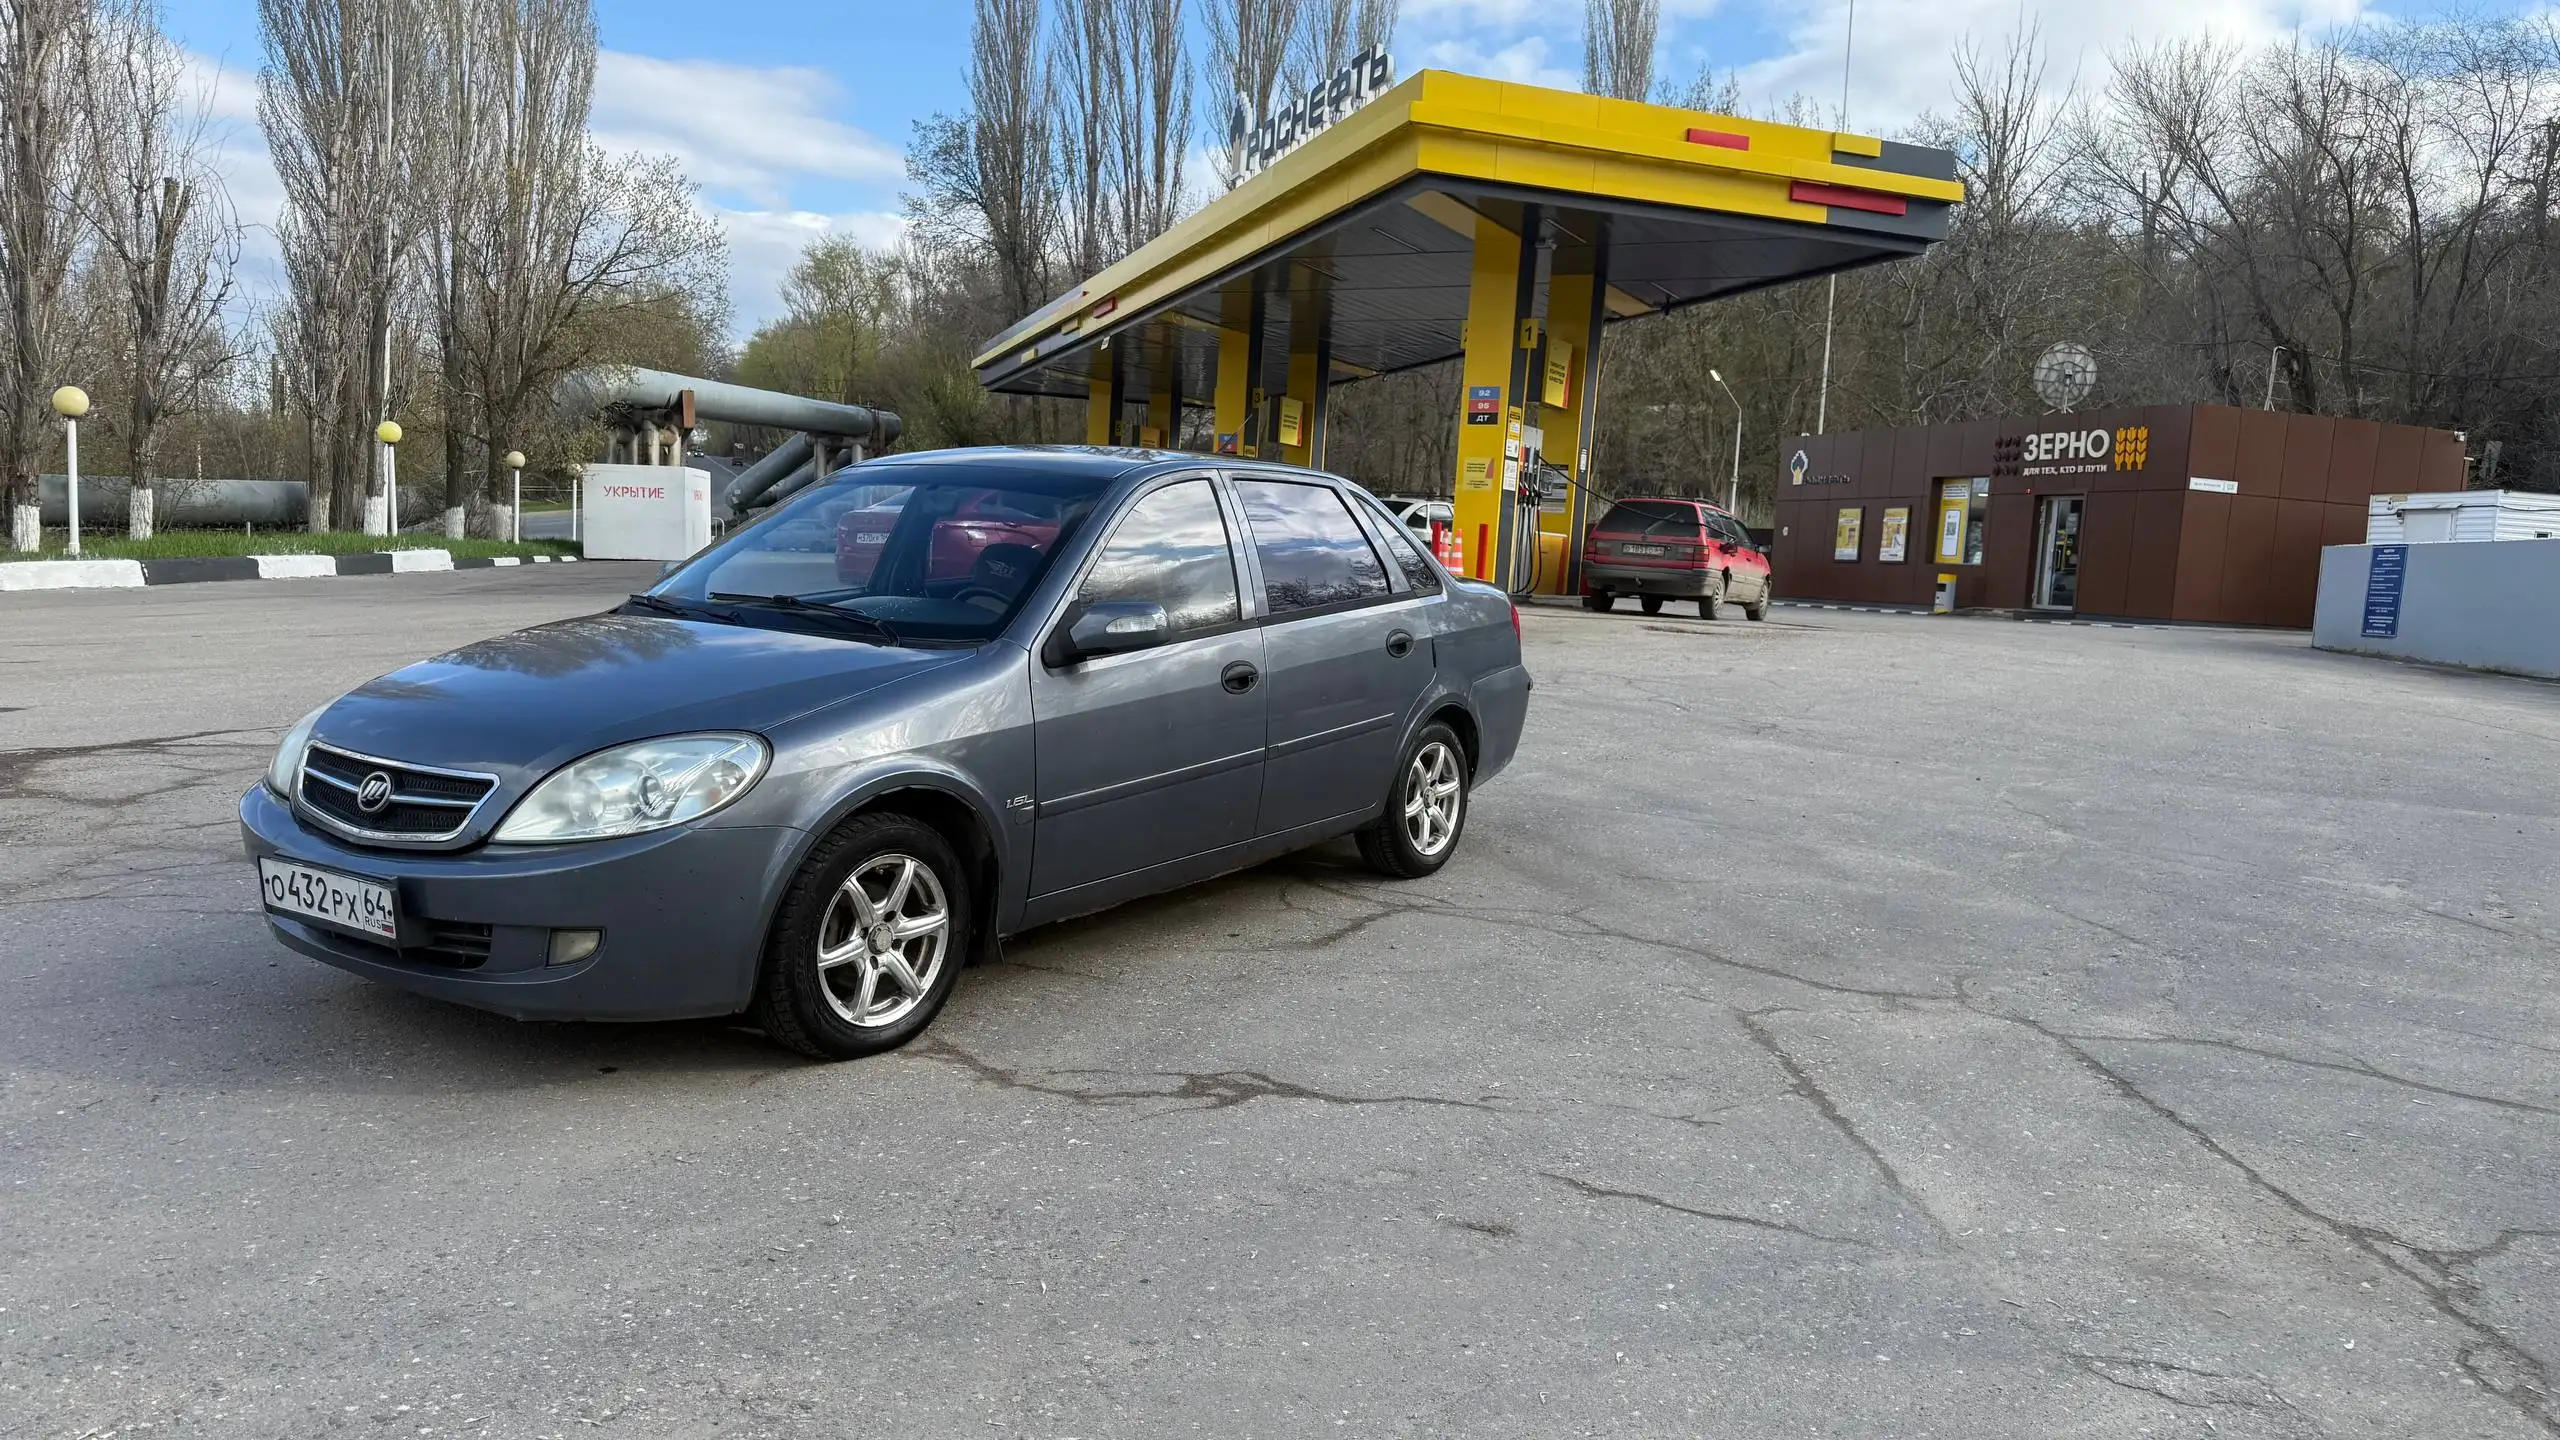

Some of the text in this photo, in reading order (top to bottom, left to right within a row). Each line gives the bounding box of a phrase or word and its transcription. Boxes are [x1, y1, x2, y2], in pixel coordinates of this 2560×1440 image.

[1246, 43, 1390, 172] РОСНЕФТЬ
[1525, 326, 1532, 341] 1
[1478, 389, 1491, 397] 92
[1477, 402, 1490, 410] 95
[2023, 429, 2110, 461] ЗЕРНО
[2023, 467, 2039, 476] ДЛЯ
[2060, 465, 2076, 474] КТО
[2078, 465, 2083, 473] В
[2085, 464, 2107, 473] ПУТИ
[604, 486, 665, 499] УКРЫТИЕ
[271, 870, 360, 923] О432РХ
[365, 915, 382, 929] RUS
